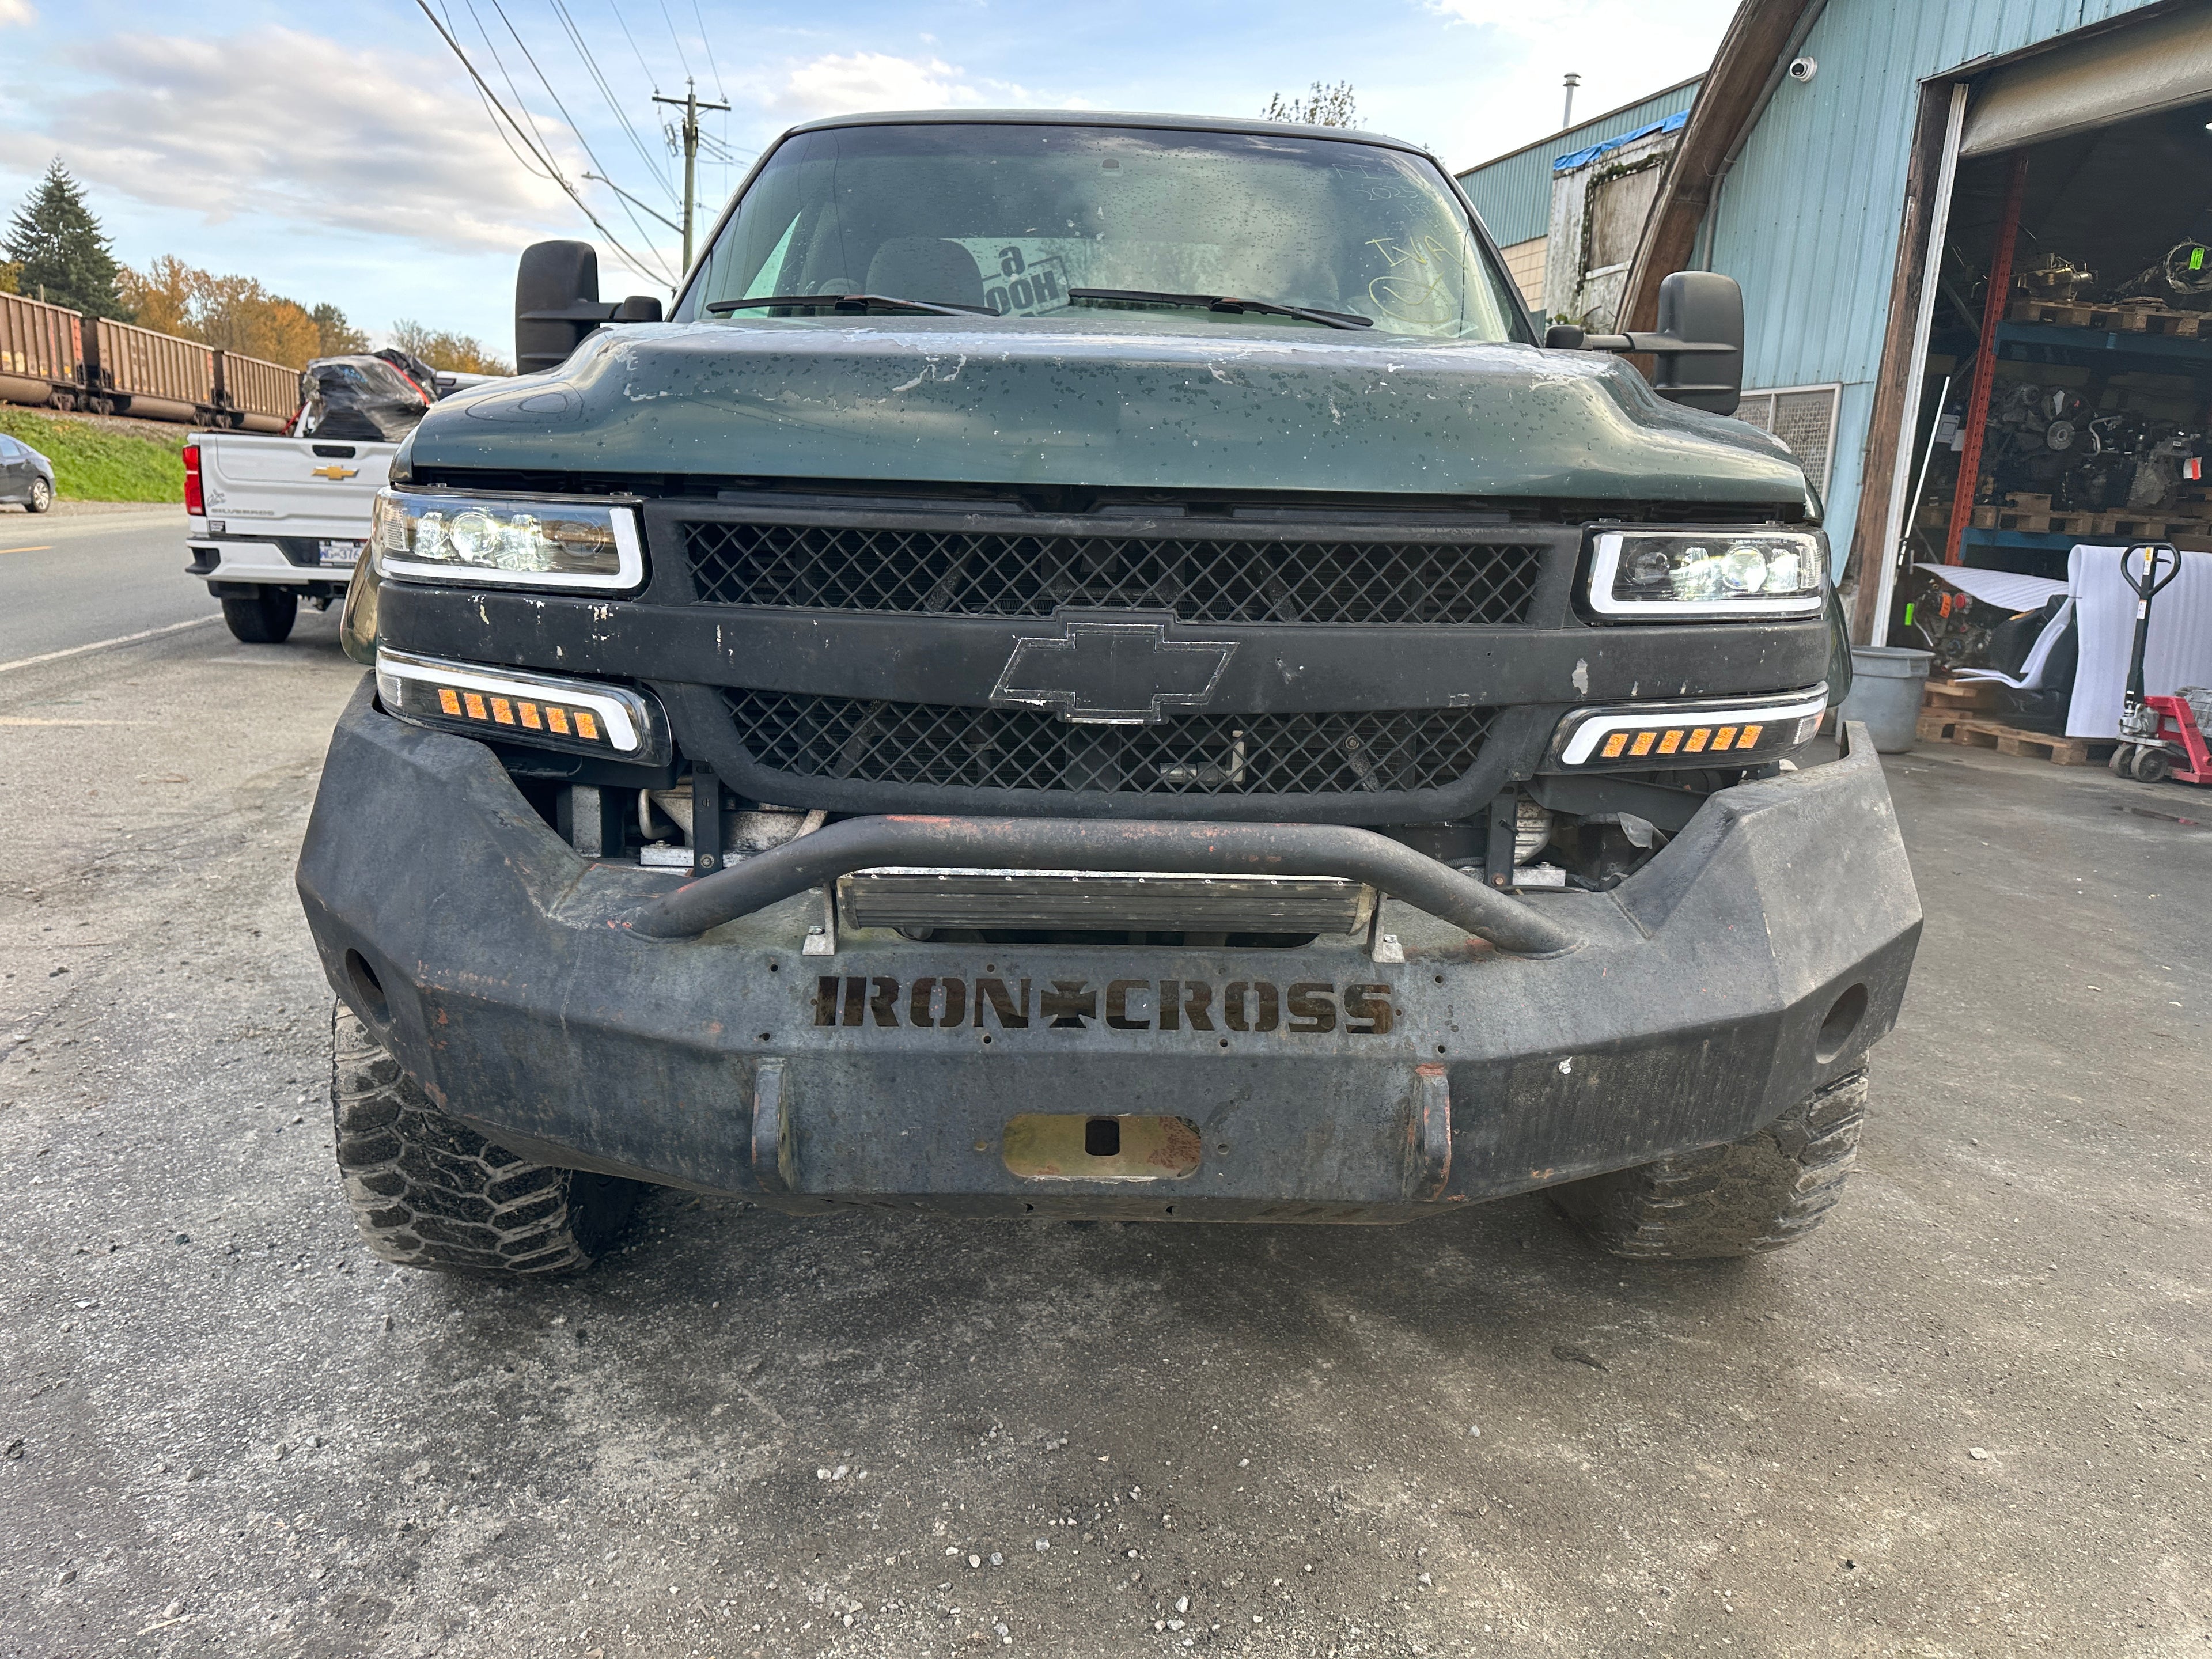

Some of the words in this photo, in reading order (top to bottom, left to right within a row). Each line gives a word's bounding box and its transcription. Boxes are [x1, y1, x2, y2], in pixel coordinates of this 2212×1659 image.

[1355, 185, 1419, 201] 2025
[813, 975, 1032, 1028] IRON
[1105, 979, 1395, 1035] CROSS
